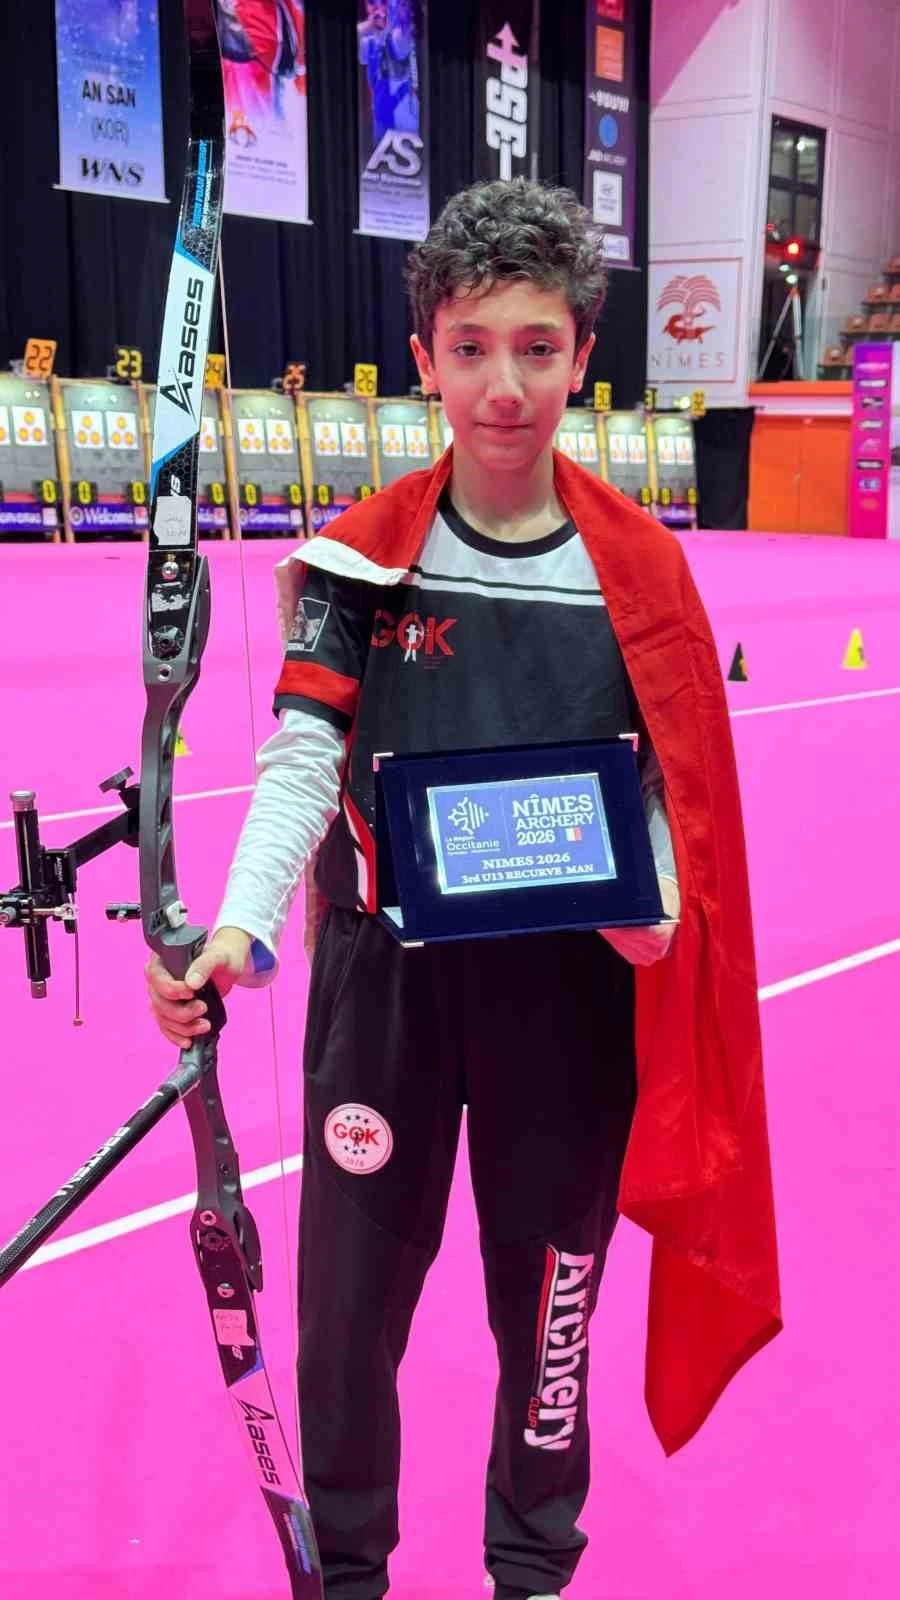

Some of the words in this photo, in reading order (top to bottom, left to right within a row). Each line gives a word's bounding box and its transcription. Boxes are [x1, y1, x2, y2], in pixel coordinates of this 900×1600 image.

[82, 79, 102, 104] AN
[106, 84, 136, 109] SAN
[92, 117, 131, 147] (KOR)
[366, 129, 425, 176] AS
[81, 157, 145, 185] WNS
[26, 344, 53, 371] 22
[115, 348, 143, 379] 23
[650, 346, 724, 368] NÎMES
[358, 368, 375, 392] 26
[42, 480, 56, 504] 0
[77, 480, 92, 504] 0
[132, 480, 145, 504] 0
[211, 482, 224, 504] 0
[512, 793, 593, 818] NÎMES
[515, 812, 595, 831] ARCHERY
[447, 840, 500, 851] Occitanie
[516, 829, 556, 846] 2026
[481, 855, 534, 870] NIMES
[536, 852, 571, 865] 2026
[461, 873, 480, 884] 3rd
[481, 871, 504, 882] U13
[505, 866, 562, 879] RECURVE
[566, 863, 594, 874] MAN
[333, 1122, 380, 1146] GOK
[524, 1251, 595, 1450] Archery
